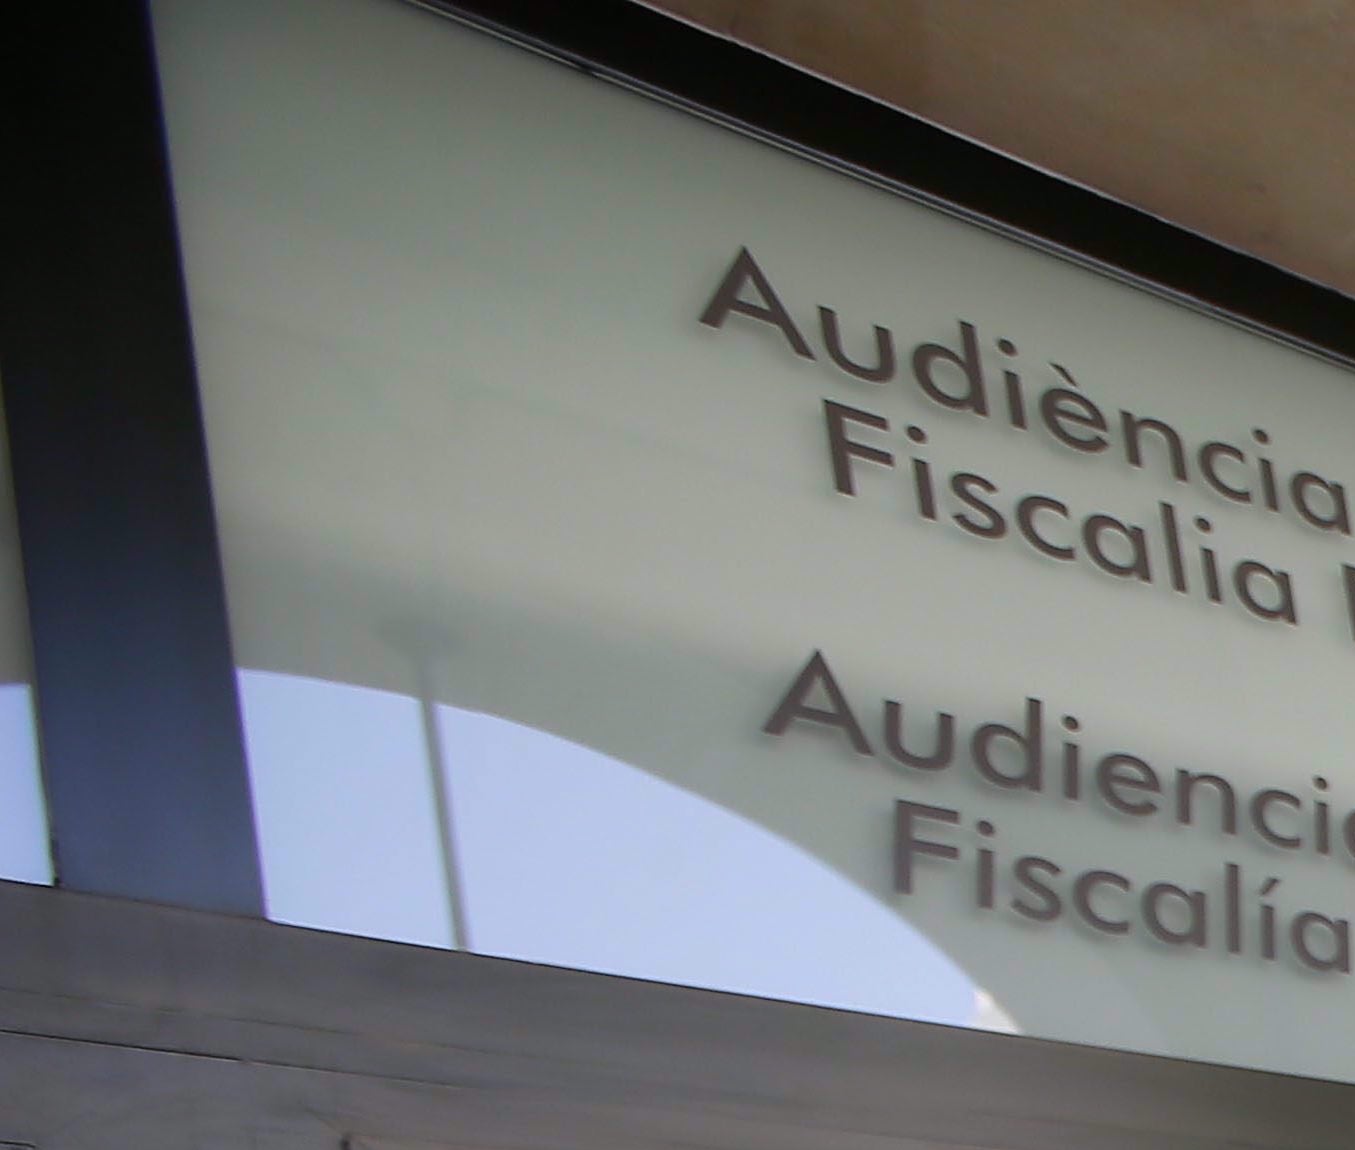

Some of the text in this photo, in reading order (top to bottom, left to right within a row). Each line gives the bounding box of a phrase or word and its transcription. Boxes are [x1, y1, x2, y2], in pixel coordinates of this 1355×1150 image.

[699, 245, 1353, 537] Audiència
[822, 399, 1298, 626] Fiscalia
[893, 800, 1351, 975] Fiscalía
